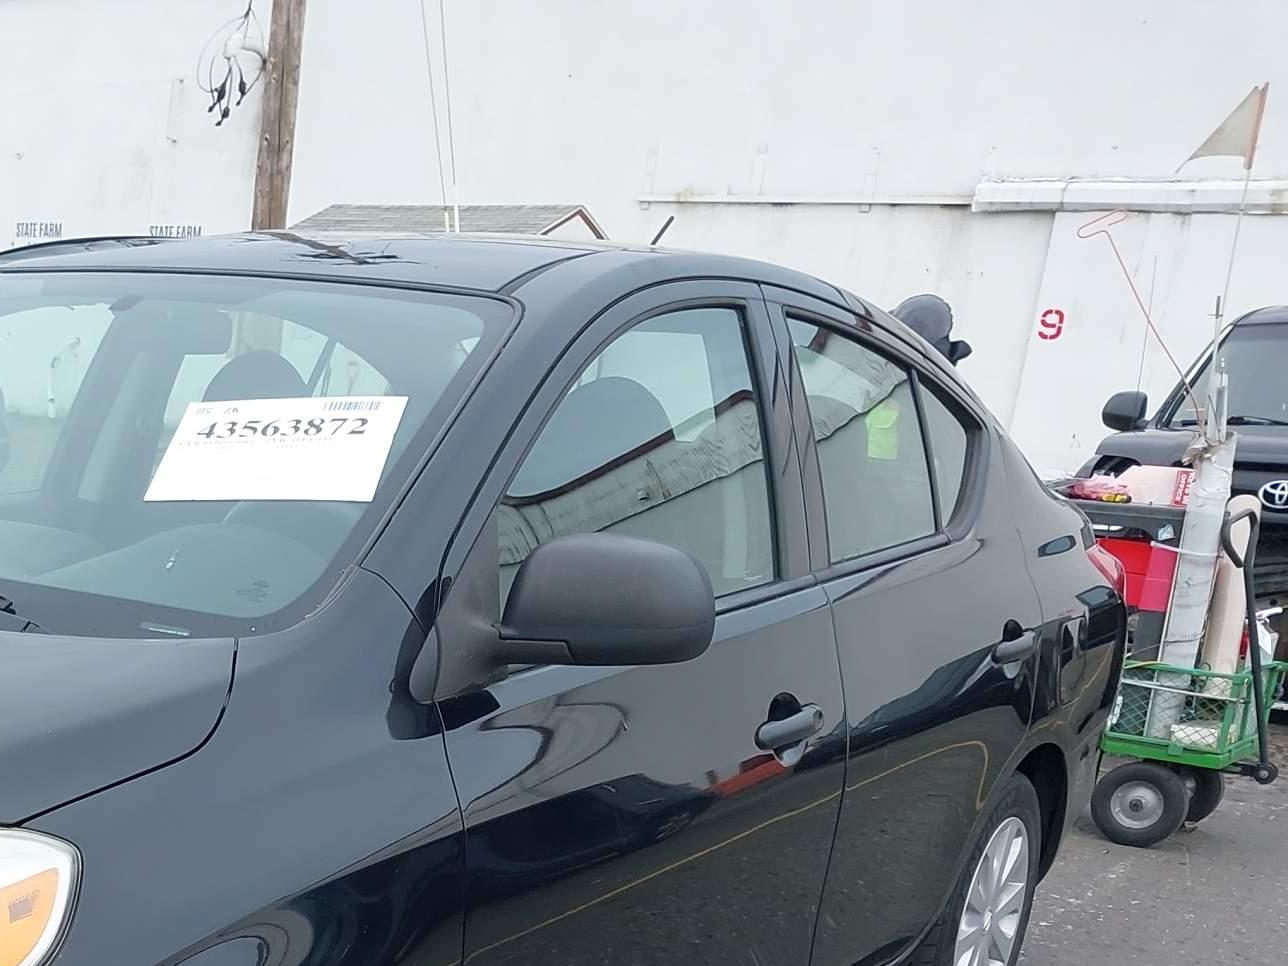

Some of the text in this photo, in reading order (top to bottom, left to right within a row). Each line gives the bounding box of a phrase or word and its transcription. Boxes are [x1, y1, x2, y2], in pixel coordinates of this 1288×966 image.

[16, 222, 63, 238] STATE FARM
[149, 225, 202, 239] STATE FARM
[1038, 308, 1065, 340] 9
[195, 417, 370, 440] 43563872
[1175, 473, 1187, 502] OFFICE
